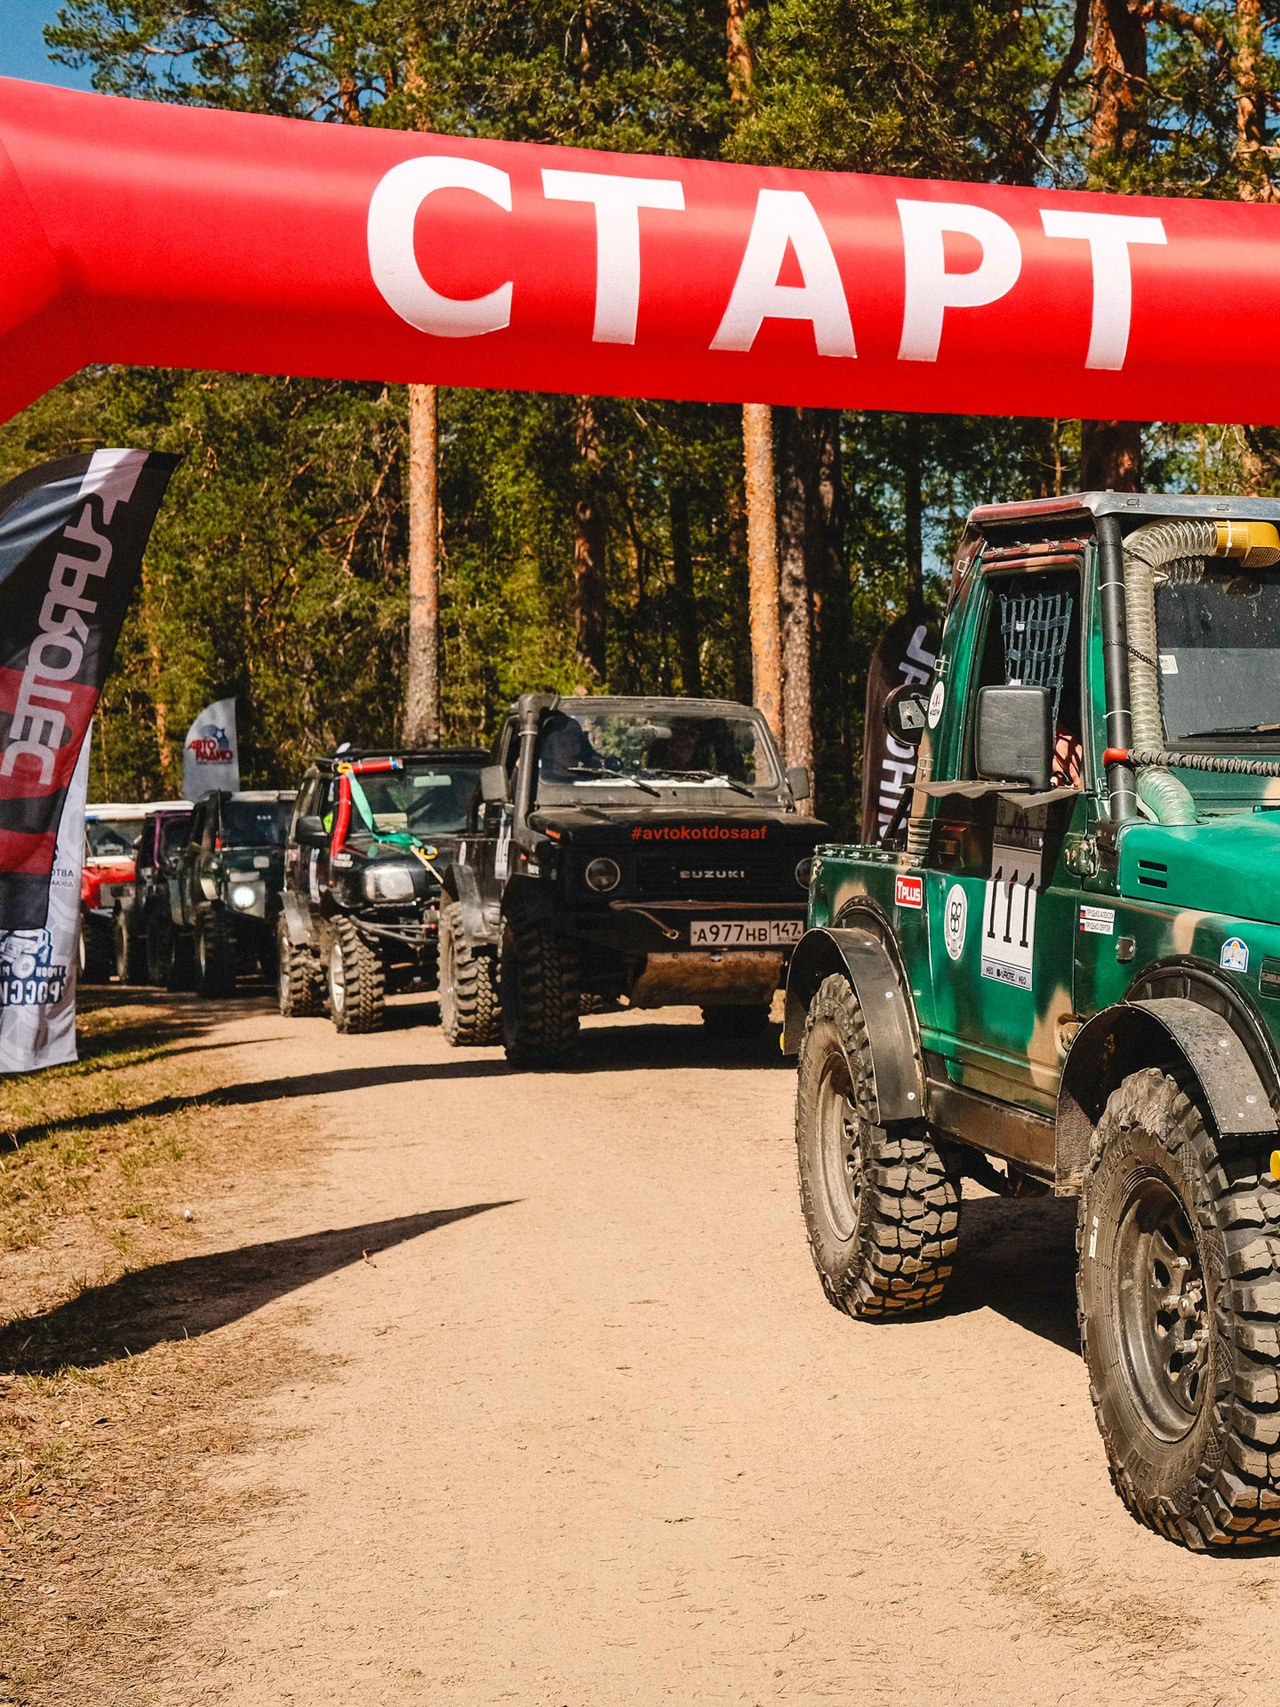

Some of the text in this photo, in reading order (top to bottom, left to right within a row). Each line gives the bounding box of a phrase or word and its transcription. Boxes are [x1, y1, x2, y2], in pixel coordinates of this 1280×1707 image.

[366, 155, 1168, 371] СТАРТ
[631, 826, 768, 840] #avtokotdosaaf
[680, 870, 745, 879] SUZUKI
[987, 866, 1034, 948] 111
[772, 922, 799, 936] 147
